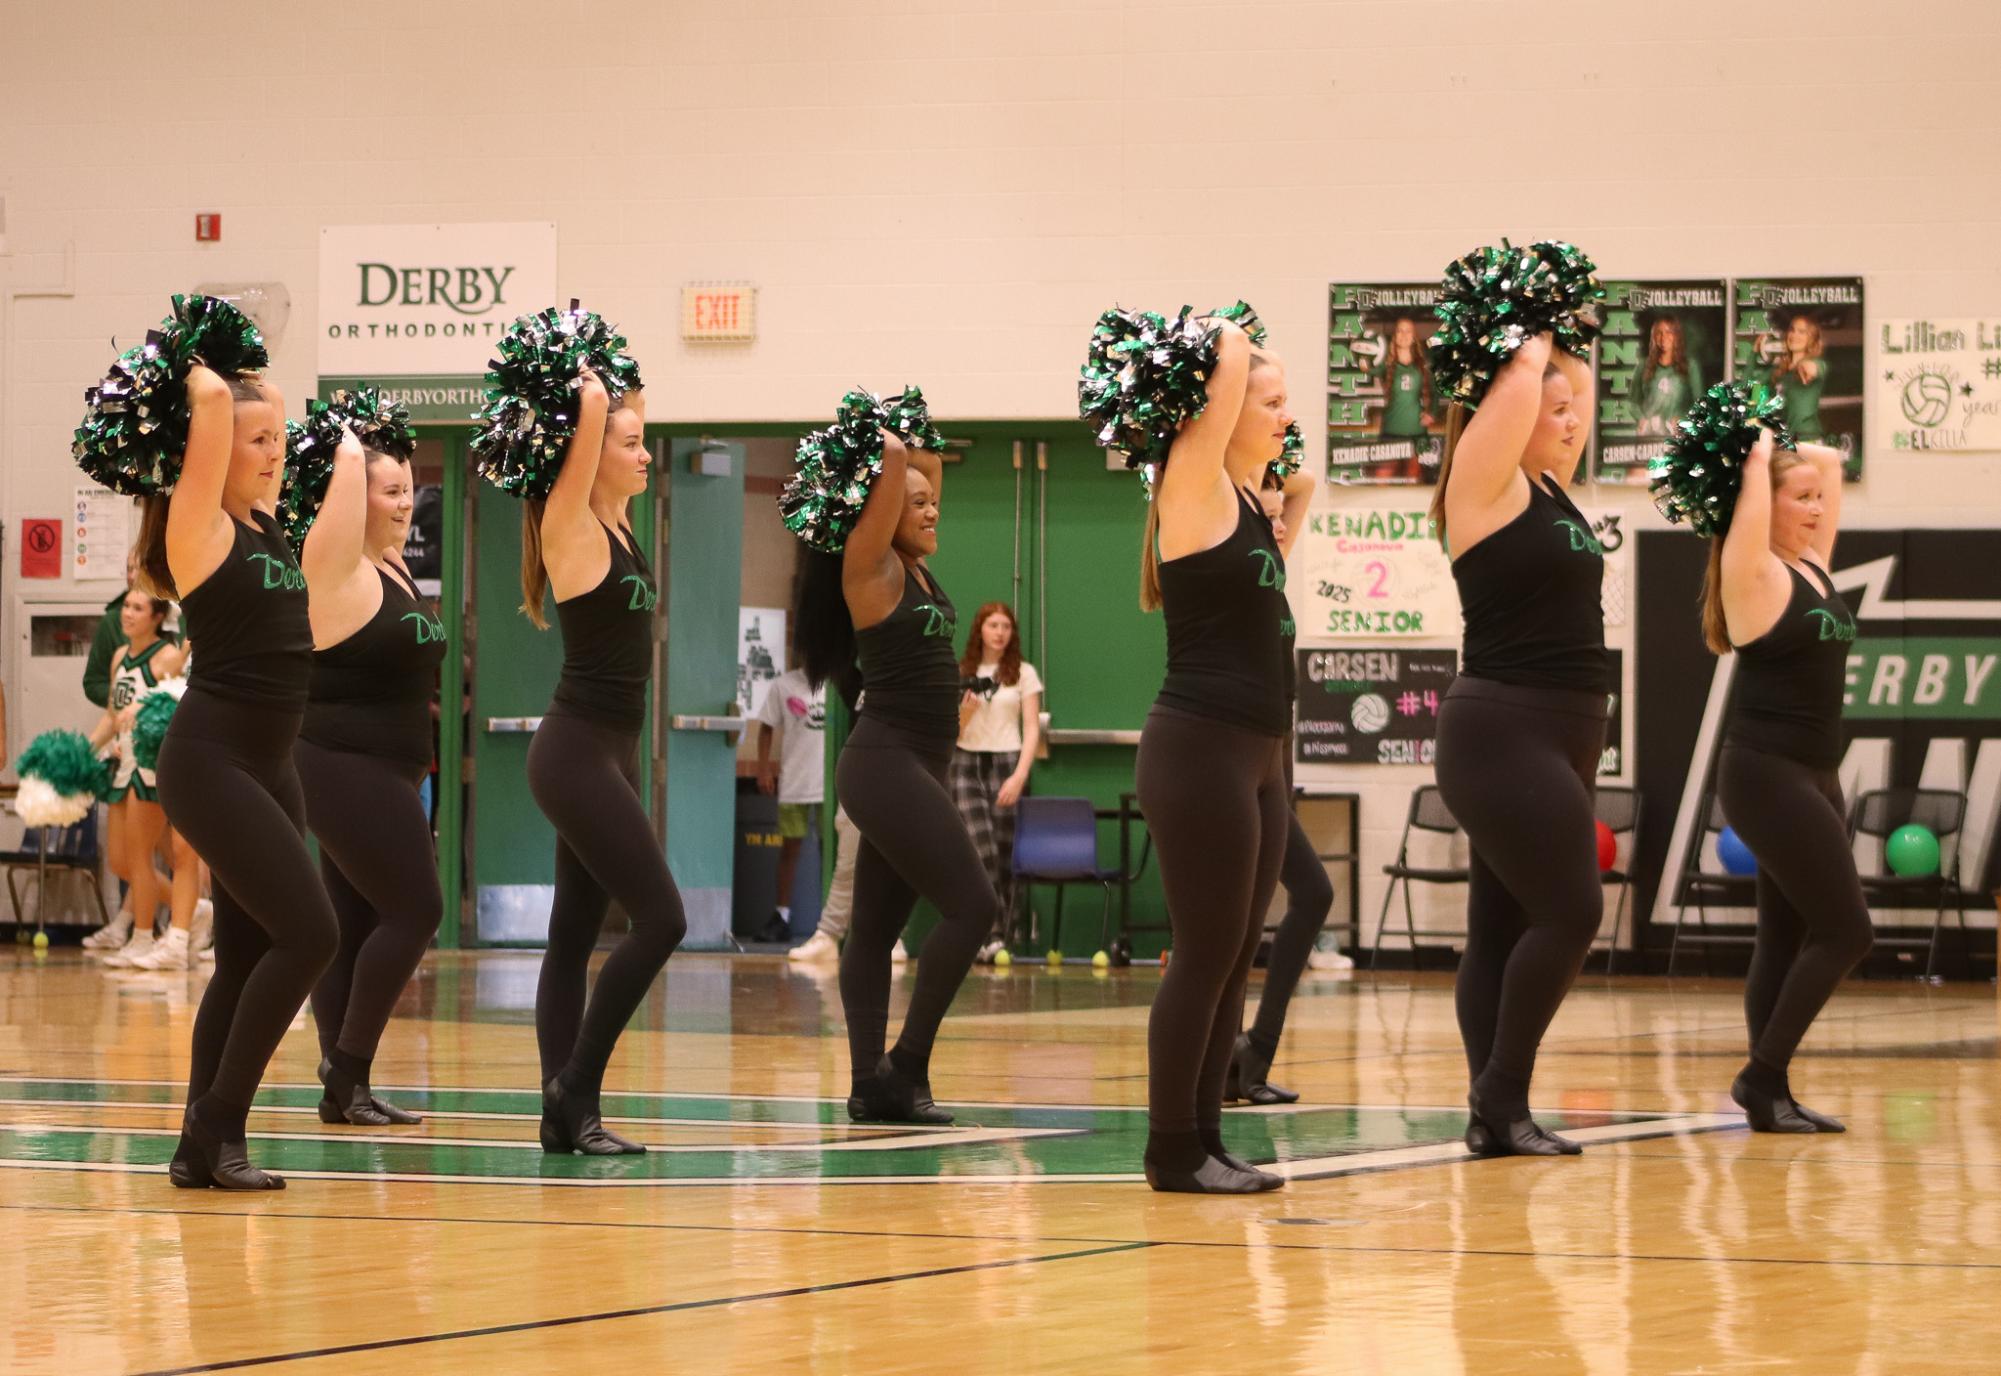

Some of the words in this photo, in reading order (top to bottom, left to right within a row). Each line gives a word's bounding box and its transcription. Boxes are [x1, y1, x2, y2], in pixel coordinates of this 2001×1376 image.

[356, 263, 516, 315] DERBY
[1647, 289, 1723, 307] VOLLEYBALL
[1782, 287, 1859, 305] VOLLEYBALL
[695, 294, 740, 330] EXIT
[1881, 320, 1967, 353] Lillian
[1316, 580, 1351, 604] 2025
[1365, 560, 1390, 598] 2
[1327, 609, 1423, 633] SENIOR
[1307, 652, 1398, 683] CARSEN
[1395, 689, 1439, 716] #4
[1377, 739, 1437, 764] SENIO
